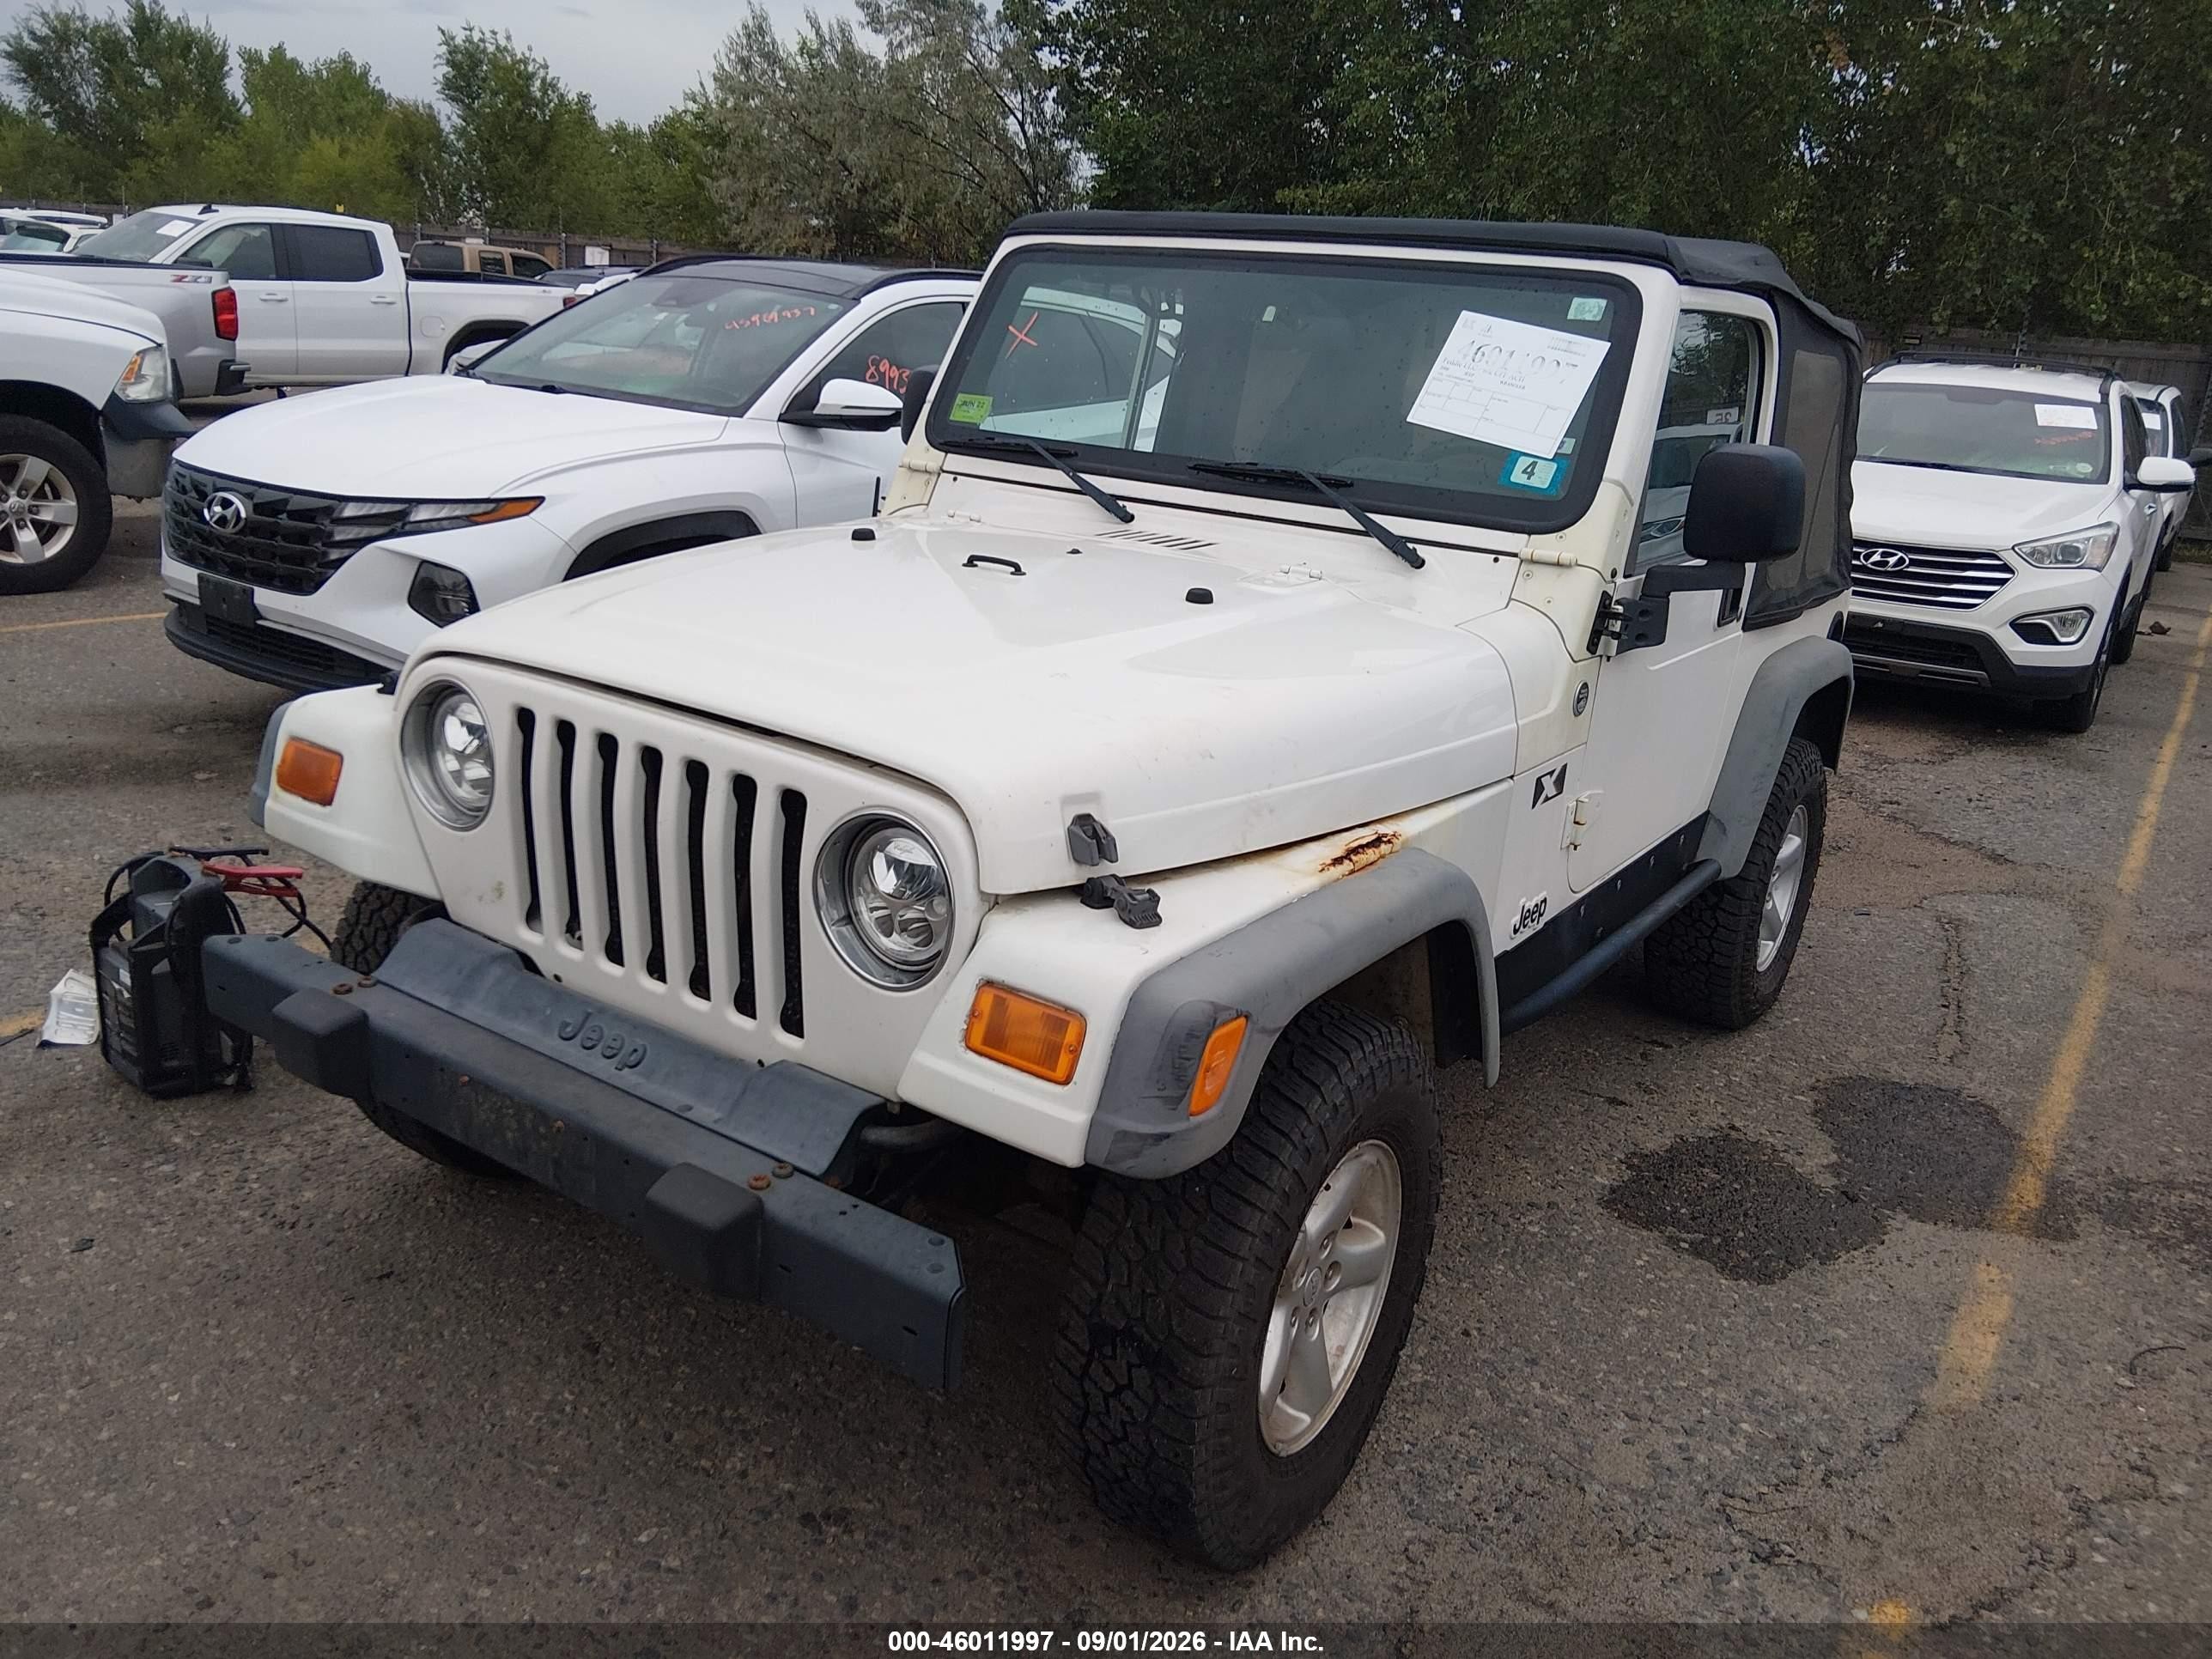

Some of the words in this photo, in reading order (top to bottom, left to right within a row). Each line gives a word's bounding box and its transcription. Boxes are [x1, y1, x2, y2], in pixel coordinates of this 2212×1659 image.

[1521, 460, 1539, 481] 4
[1513, 896, 1547, 935] Jeep
[558, 1012, 647, 1071] Jeep
